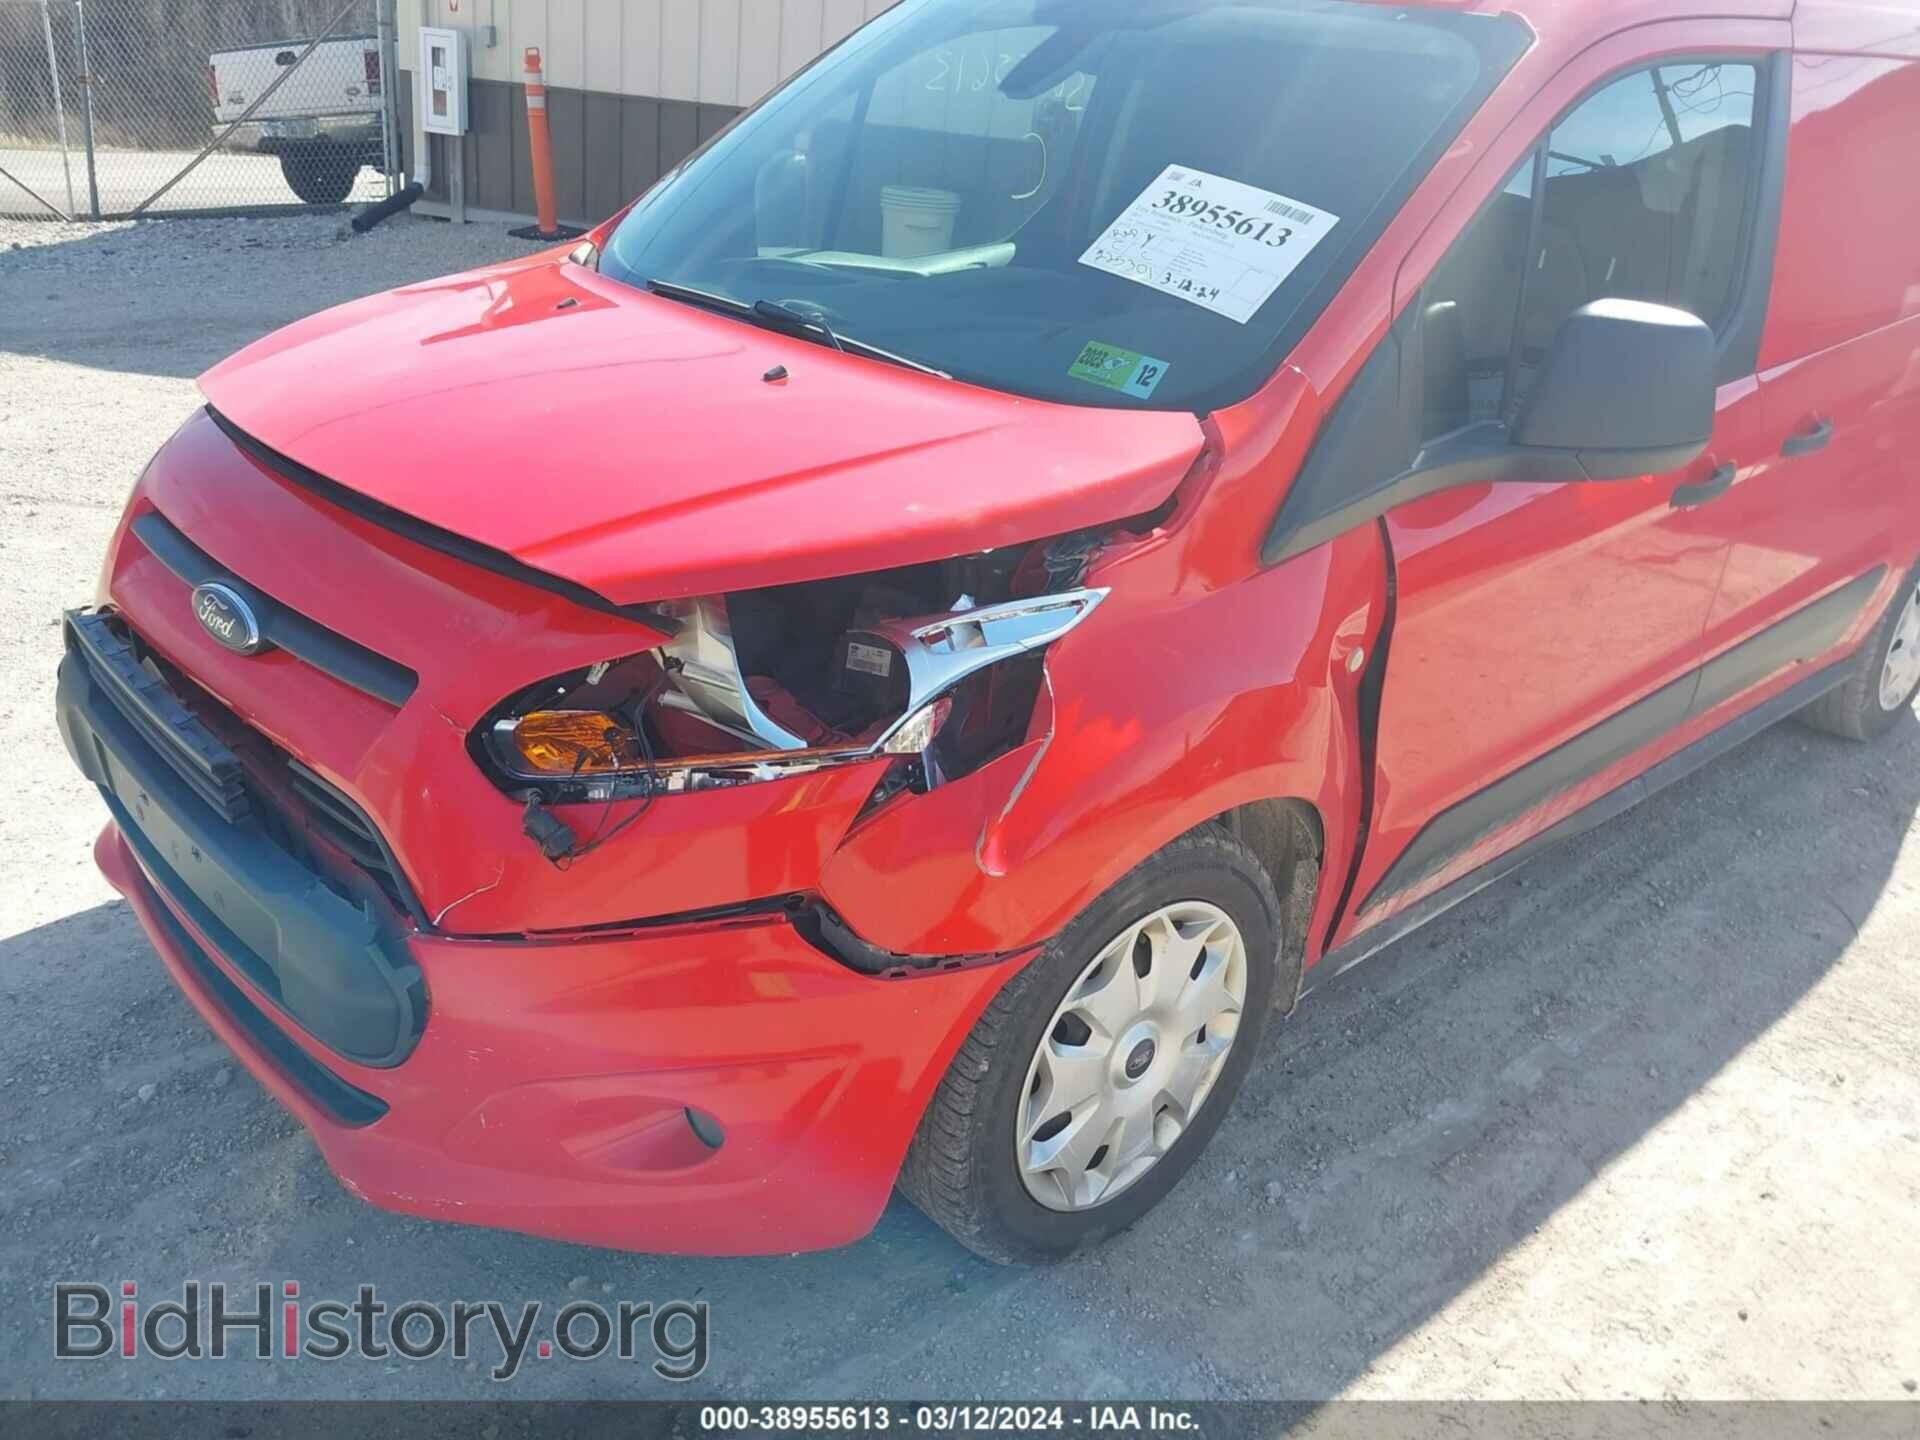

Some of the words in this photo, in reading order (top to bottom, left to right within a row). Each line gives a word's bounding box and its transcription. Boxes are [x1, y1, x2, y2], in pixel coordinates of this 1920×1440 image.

[1151, 190, 1293, 248] 38955613
[1135, 364, 1158, 387] 12
[199, 593, 234, 639] Ford
